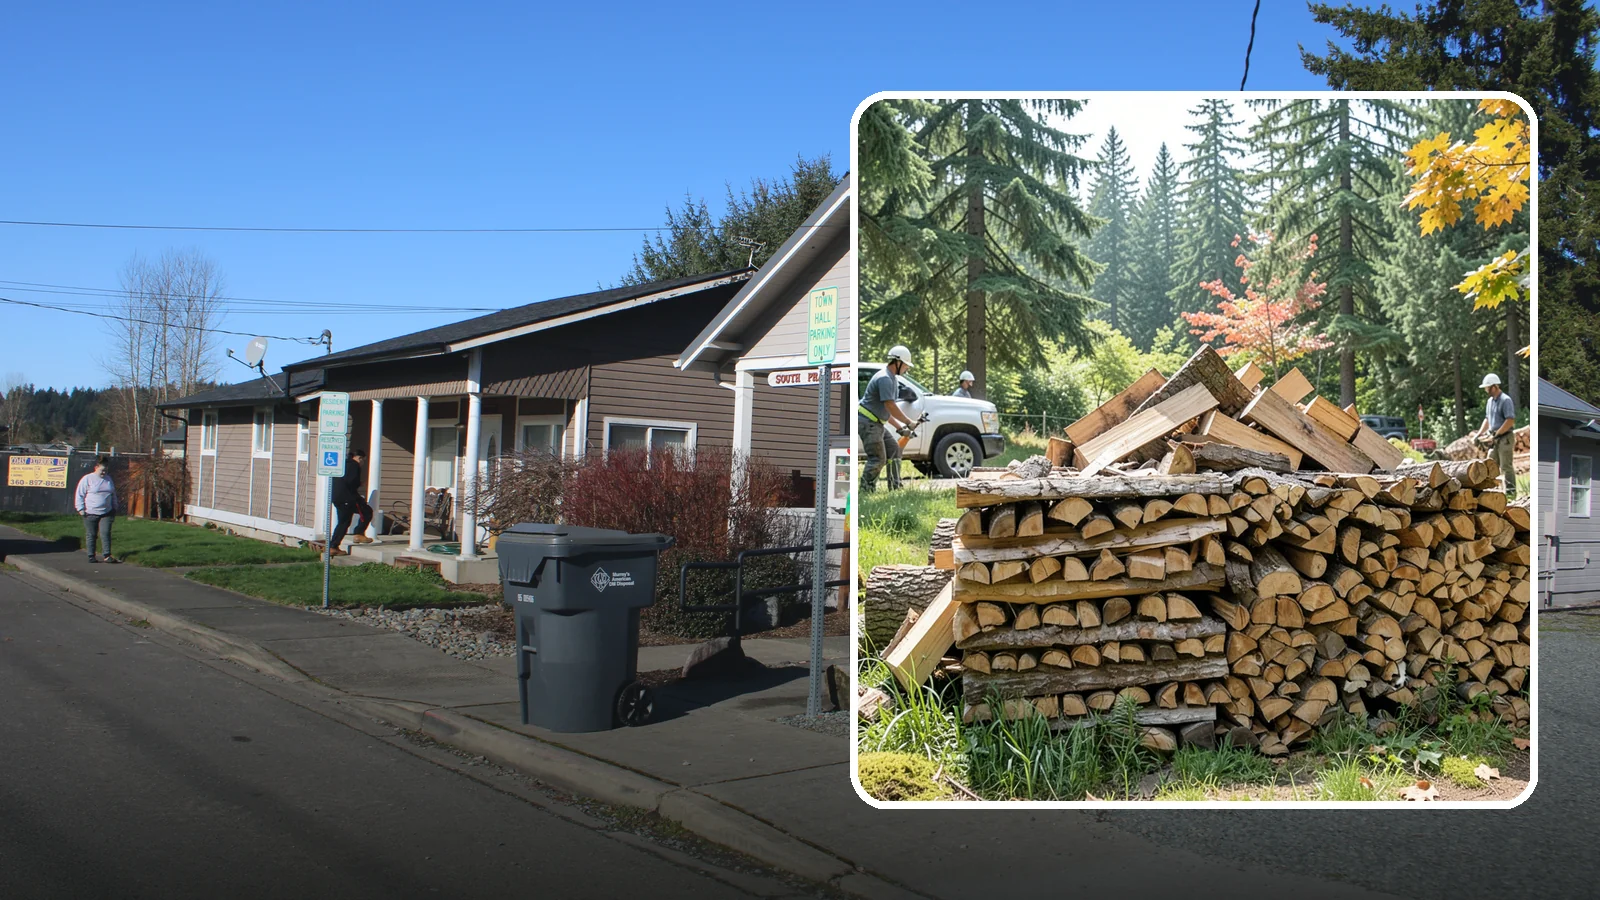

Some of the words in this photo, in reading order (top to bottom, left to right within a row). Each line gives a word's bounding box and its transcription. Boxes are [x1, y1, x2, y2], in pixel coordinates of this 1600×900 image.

[815, 294, 832, 308] TOWN
[814, 312, 831, 324] HALL
[810, 326, 836, 340] PARKING
[814, 344, 830, 357] ONLY
[776, 374, 801, 384] SOUTH
